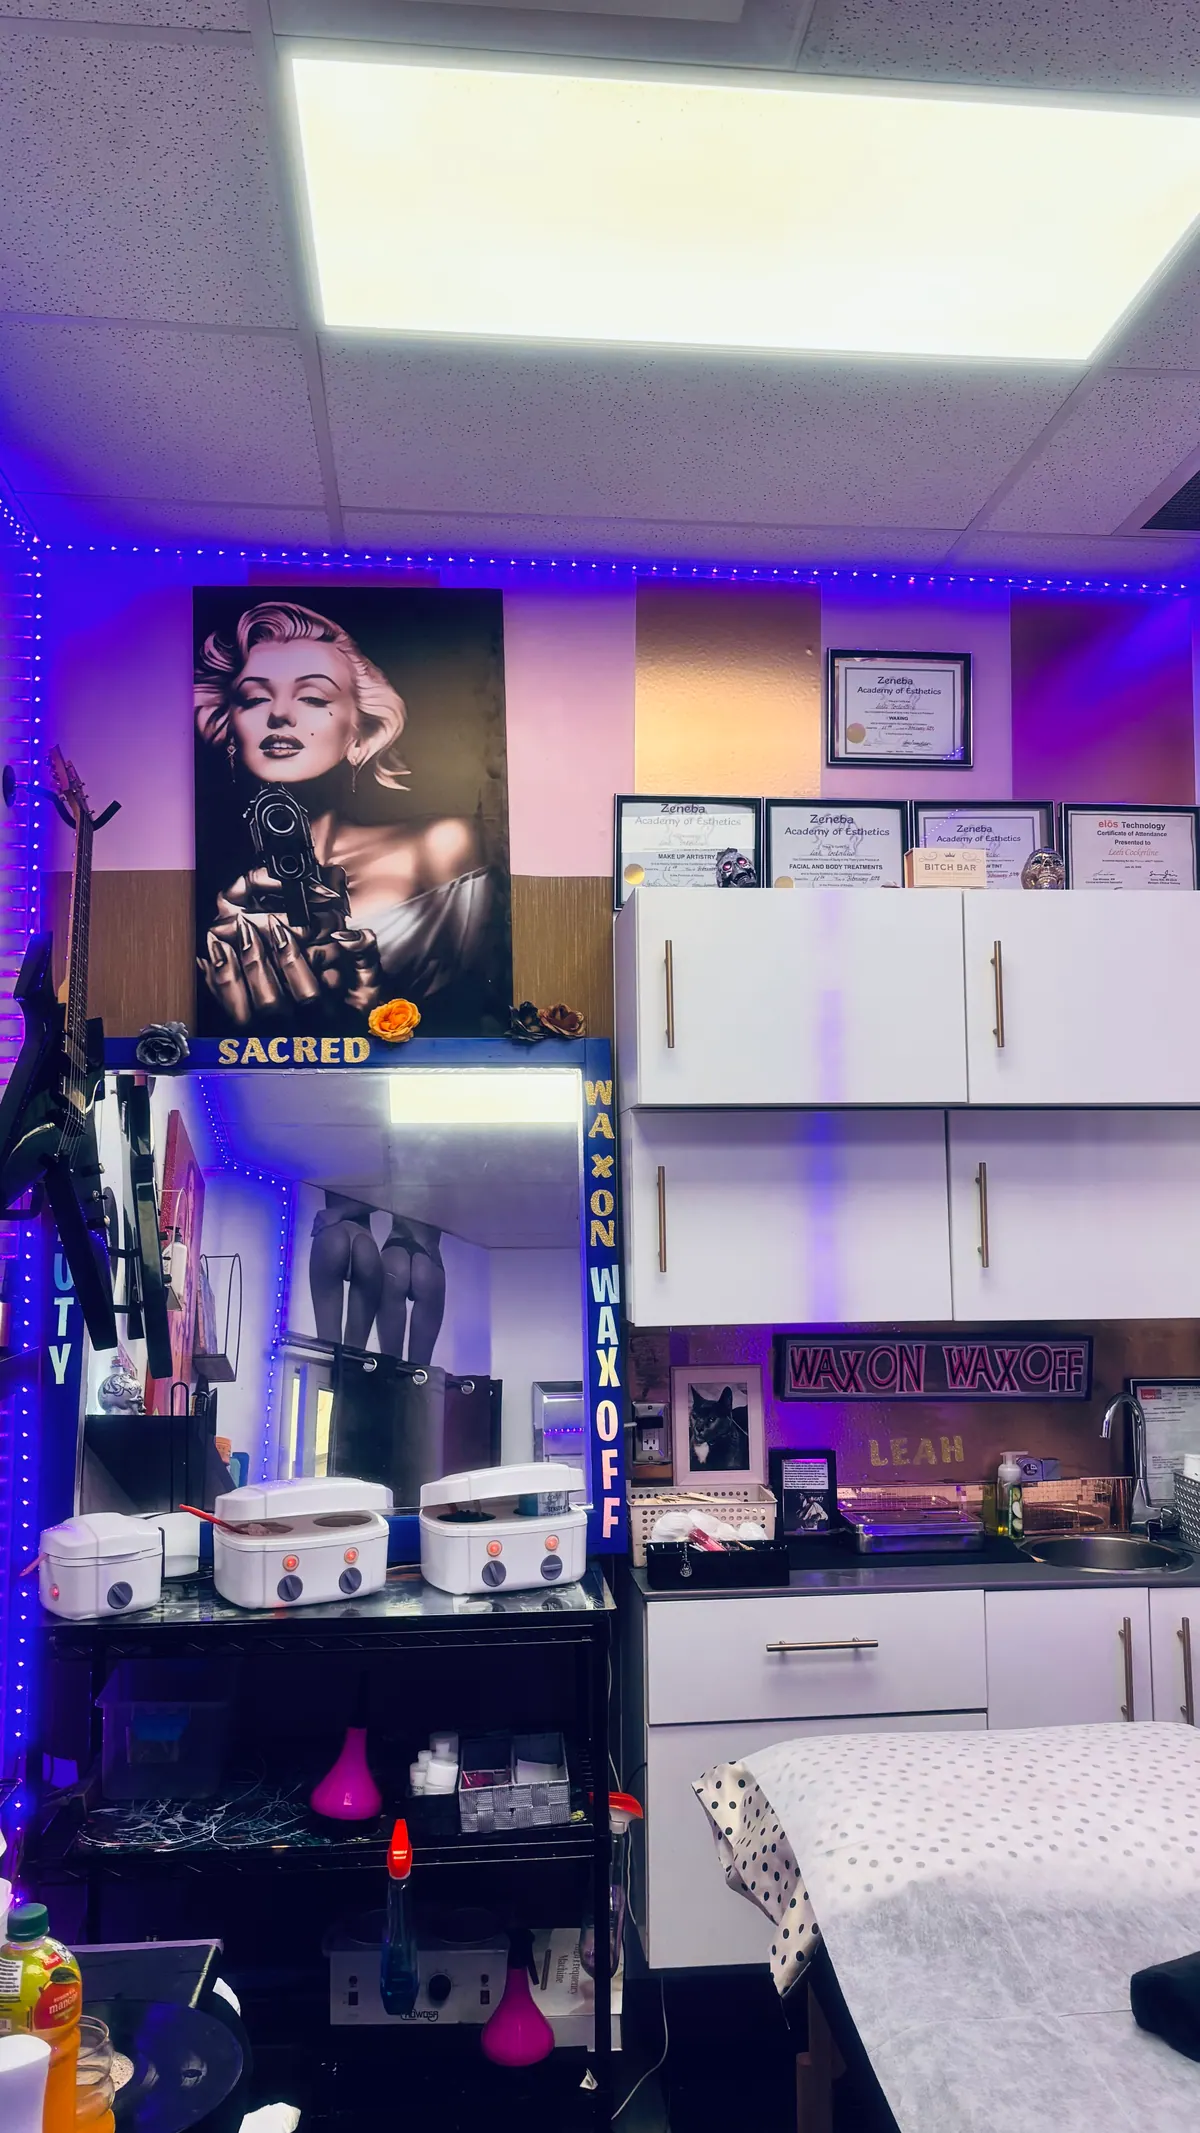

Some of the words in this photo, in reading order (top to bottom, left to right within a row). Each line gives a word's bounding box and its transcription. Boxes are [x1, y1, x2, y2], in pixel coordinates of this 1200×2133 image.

[878, 676, 913, 685] Zeneba
[857, 686, 894, 696] Academy
[906, 687, 941, 695] Esthetics
[661, 803, 706, 814] Zeneba
[635, 816, 680, 827] Academy
[684, 816, 693, 825] of
[697, 817, 741, 826] Esthetics
[810, 814, 854, 824] Zeneba
[956, 825, 993, 833] Zeneba
[1121, 821, 1166, 831] Technology
[784, 827, 829, 837] Academy
[845, 828, 890, 836] Esthetics
[936, 835, 973, 844] Academy
[924, 863, 954, 871] BITCH
[218, 1036, 371, 1065] SACRED
[48, 1246, 75, 1385] UTY
[868, 1435, 965, 1467] LEAH
